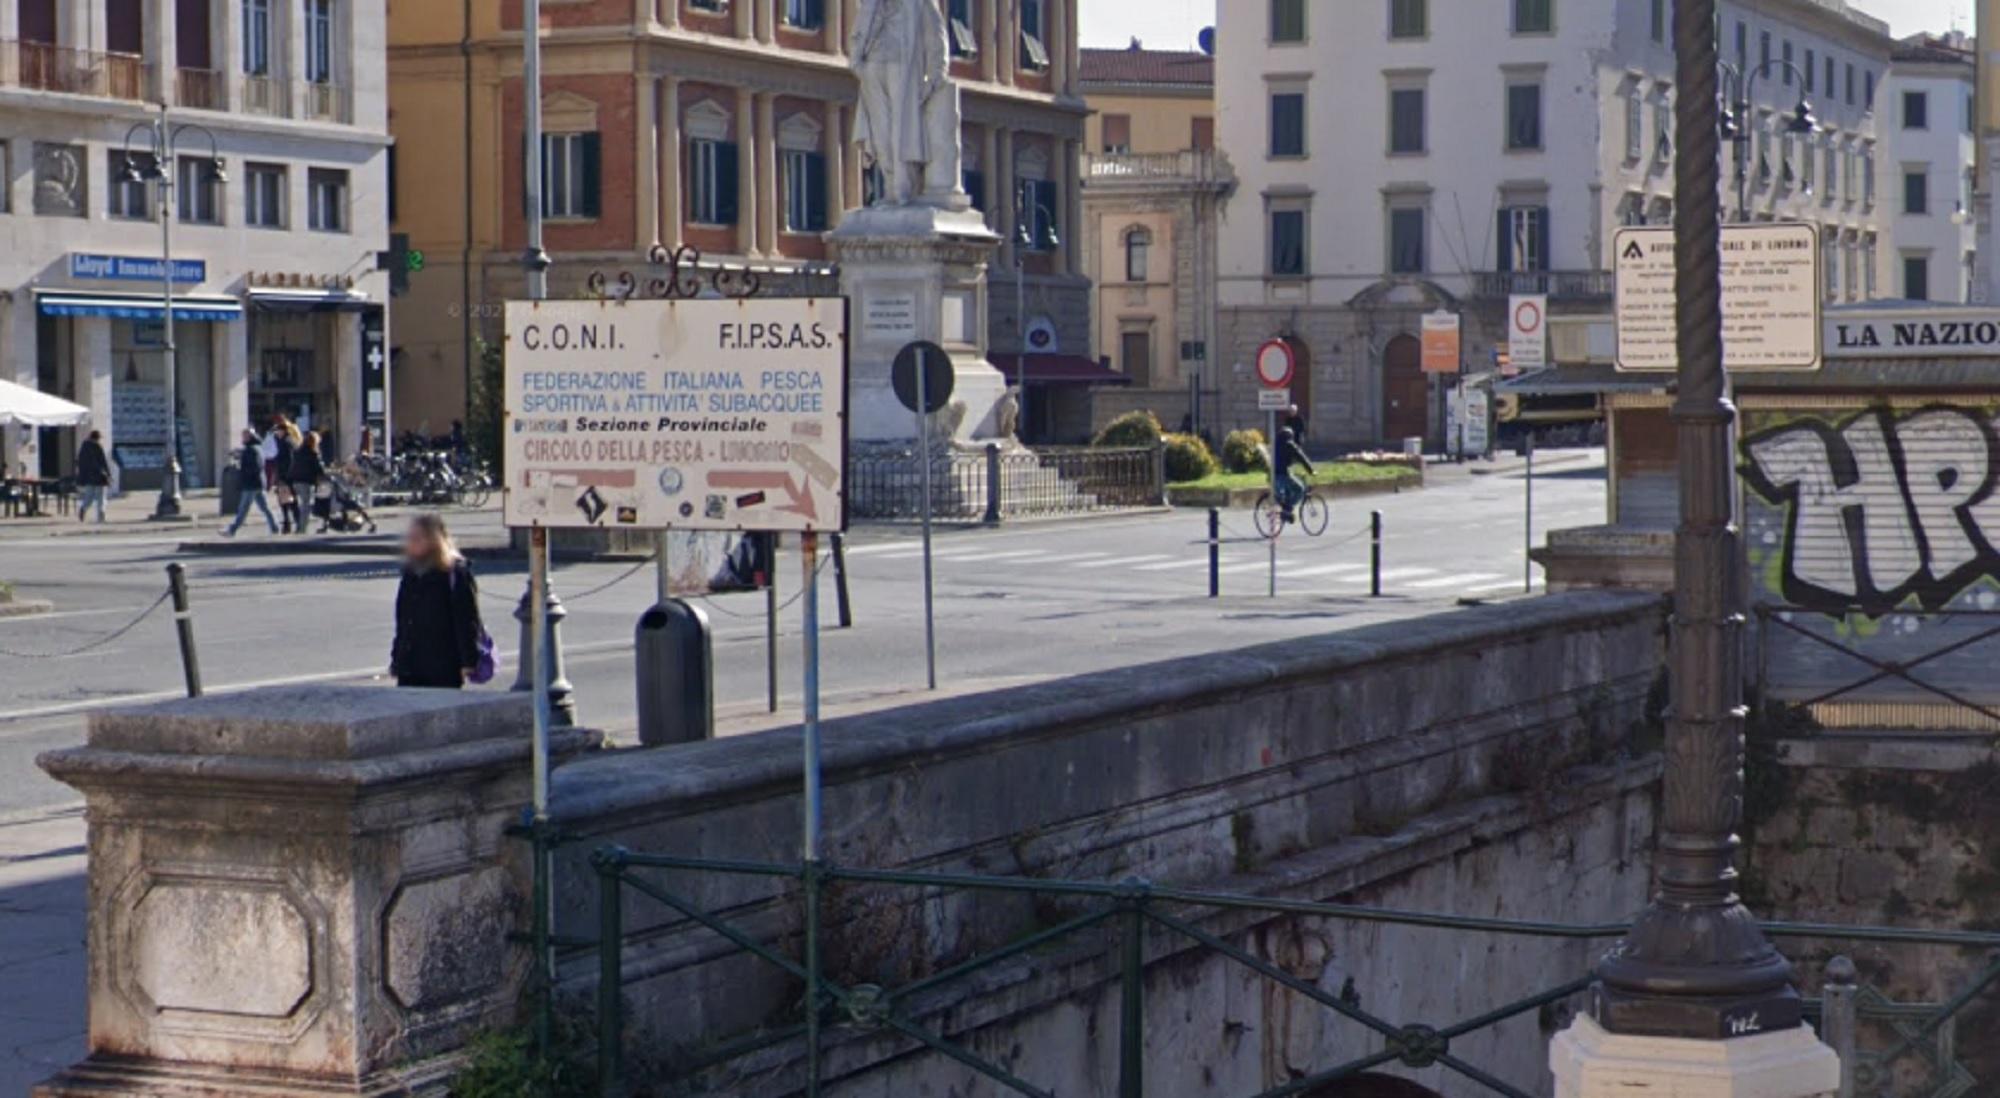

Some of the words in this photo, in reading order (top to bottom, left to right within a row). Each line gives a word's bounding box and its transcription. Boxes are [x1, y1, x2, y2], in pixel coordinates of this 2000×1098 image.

[76, 256, 113, 276] Lloyd
[523, 323, 624, 351] C.O.N.I.
[719, 322, 832, 349] F.I.P.S.A.S.
[1837, 323, 1881, 348] LA
[1893, 321, 2000, 347] NAZIO
[523, 371, 646, 390] FEDERAZIONE
[664, 371, 744, 390] ITALIANA
[761, 371, 823, 390] PESCA
[523, 394, 607, 413] SPORTIVA
[709, 393, 823, 413] SUBACQUEE
[576, 416, 650, 432] Sezione
[657, 417, 767, 432] Provinciale
[524, 440, 592, 462] CIRCOLO
[598, 440, 646, 462] DELLA
[652, 440, 704, 463] PESCA
